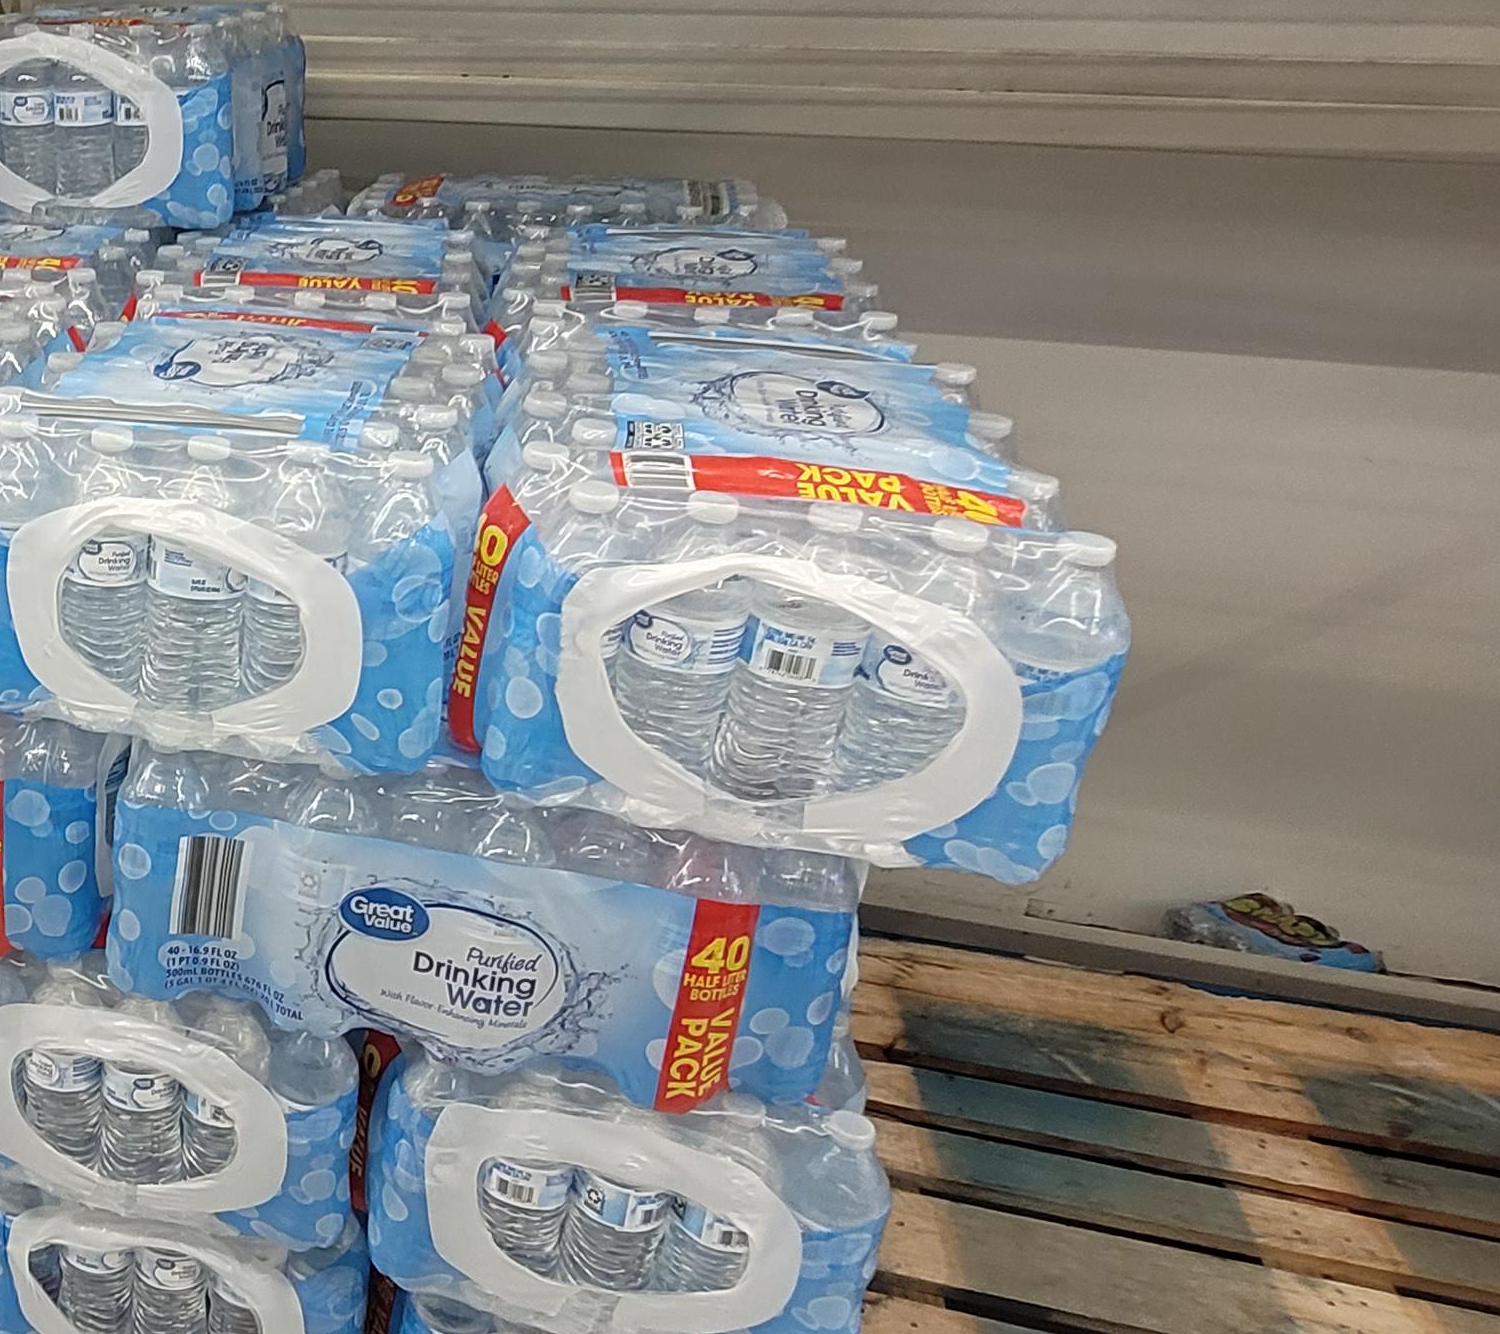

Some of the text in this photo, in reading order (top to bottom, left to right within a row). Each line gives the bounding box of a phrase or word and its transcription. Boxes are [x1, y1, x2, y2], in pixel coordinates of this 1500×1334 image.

[796, 463, 903, 488] PACK
[798, 481, 914, 513] VALUE
[452, 605, 487, 699] VALUE
[645, 631, 684, 651] Drinking
[350, 895, 415, 923] Great
[364, 914, 413, 934] Value
[167, 945, 238, 959] 40 16.9 FL OZ
[178, 956, 190, 966] PT
[192, 956, 208, 965] 0.9
[210, 958, 221, 967] FL
[466, 946, 543, 974] Purified
[691, 936, 750, 975] 40
[166, 967, 198, 979] 500mL
[201, 968, 242, 981] BOTTLES
[412, 950, 537, 1001] Drinking
[684, 969, 748, 988] HALF LITER
[447, 982, 534, 1017] Water
[690, 984, 740, 1001] BOTTLES
[275, 1004, 304, 1021] TOTAL
[665, 1018, 709, 1099] PACK
[698, 1007, 736, 1097] VALUE
